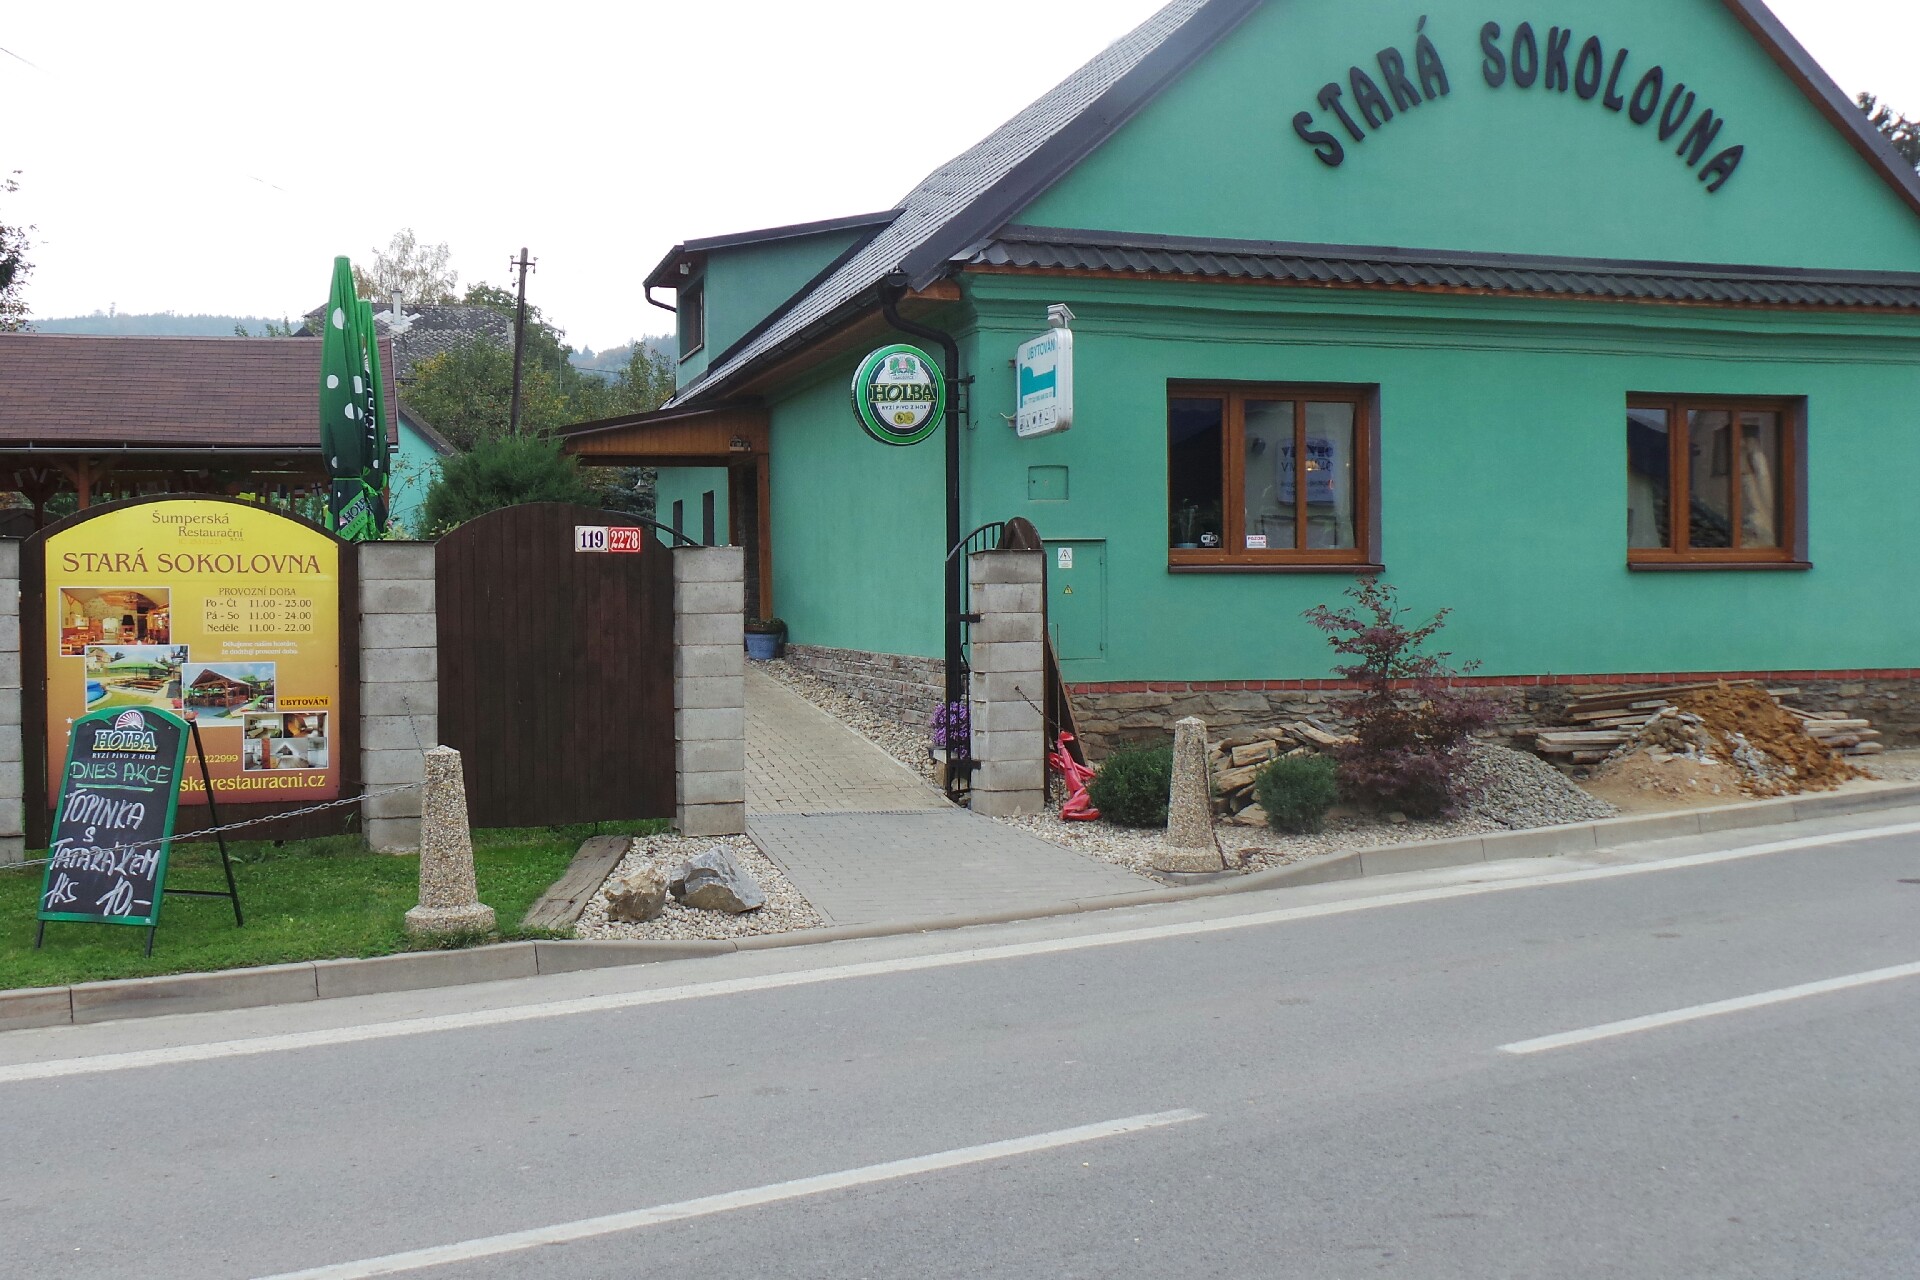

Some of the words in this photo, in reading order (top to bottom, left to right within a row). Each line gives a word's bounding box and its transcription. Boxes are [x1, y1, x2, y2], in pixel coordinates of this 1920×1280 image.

[1292, 14, 1450, 167] STARÁ
[1480, 20, 1744, 193] SOKOLOVNA
[870, 383, 936, 402] HOLBA
[152, 509, 229, 525] Šumperská
[179, 526, 243, 537] Restaurační
[581, 530, 604, 548] 119
[611, 530, 638, 549] 2278
[62, 547, 149, 572] STARÁ
[157, 553, 321, 573] SOKOLOVNA
[219, 586, 266, 595] PROVOZNÍ
[269, 588, 296, 596] DOBA
[205, 599, 217, 607] Po
[226, 598, 236, 607] Čt
[249, 599, 275, 607] 11.00
[285, 599, 311, 607] 23.00
[206, 611, 217, 619] Pá
[207, 624, 239, 632] Neděle
[249, 624, 275, 632] 11.00
[284, 624, 311, 632] 22.00
[280, 697, 328, 706] UBYTOVÁNÍ
[93, 729, 157, 752] HOLBA
[69, 761, 117, 779] DNES
[123, 762, 171, 784] AKCE
[62, 788, 145, 830] TOPINKA
[83, 826, 96, 842] S
